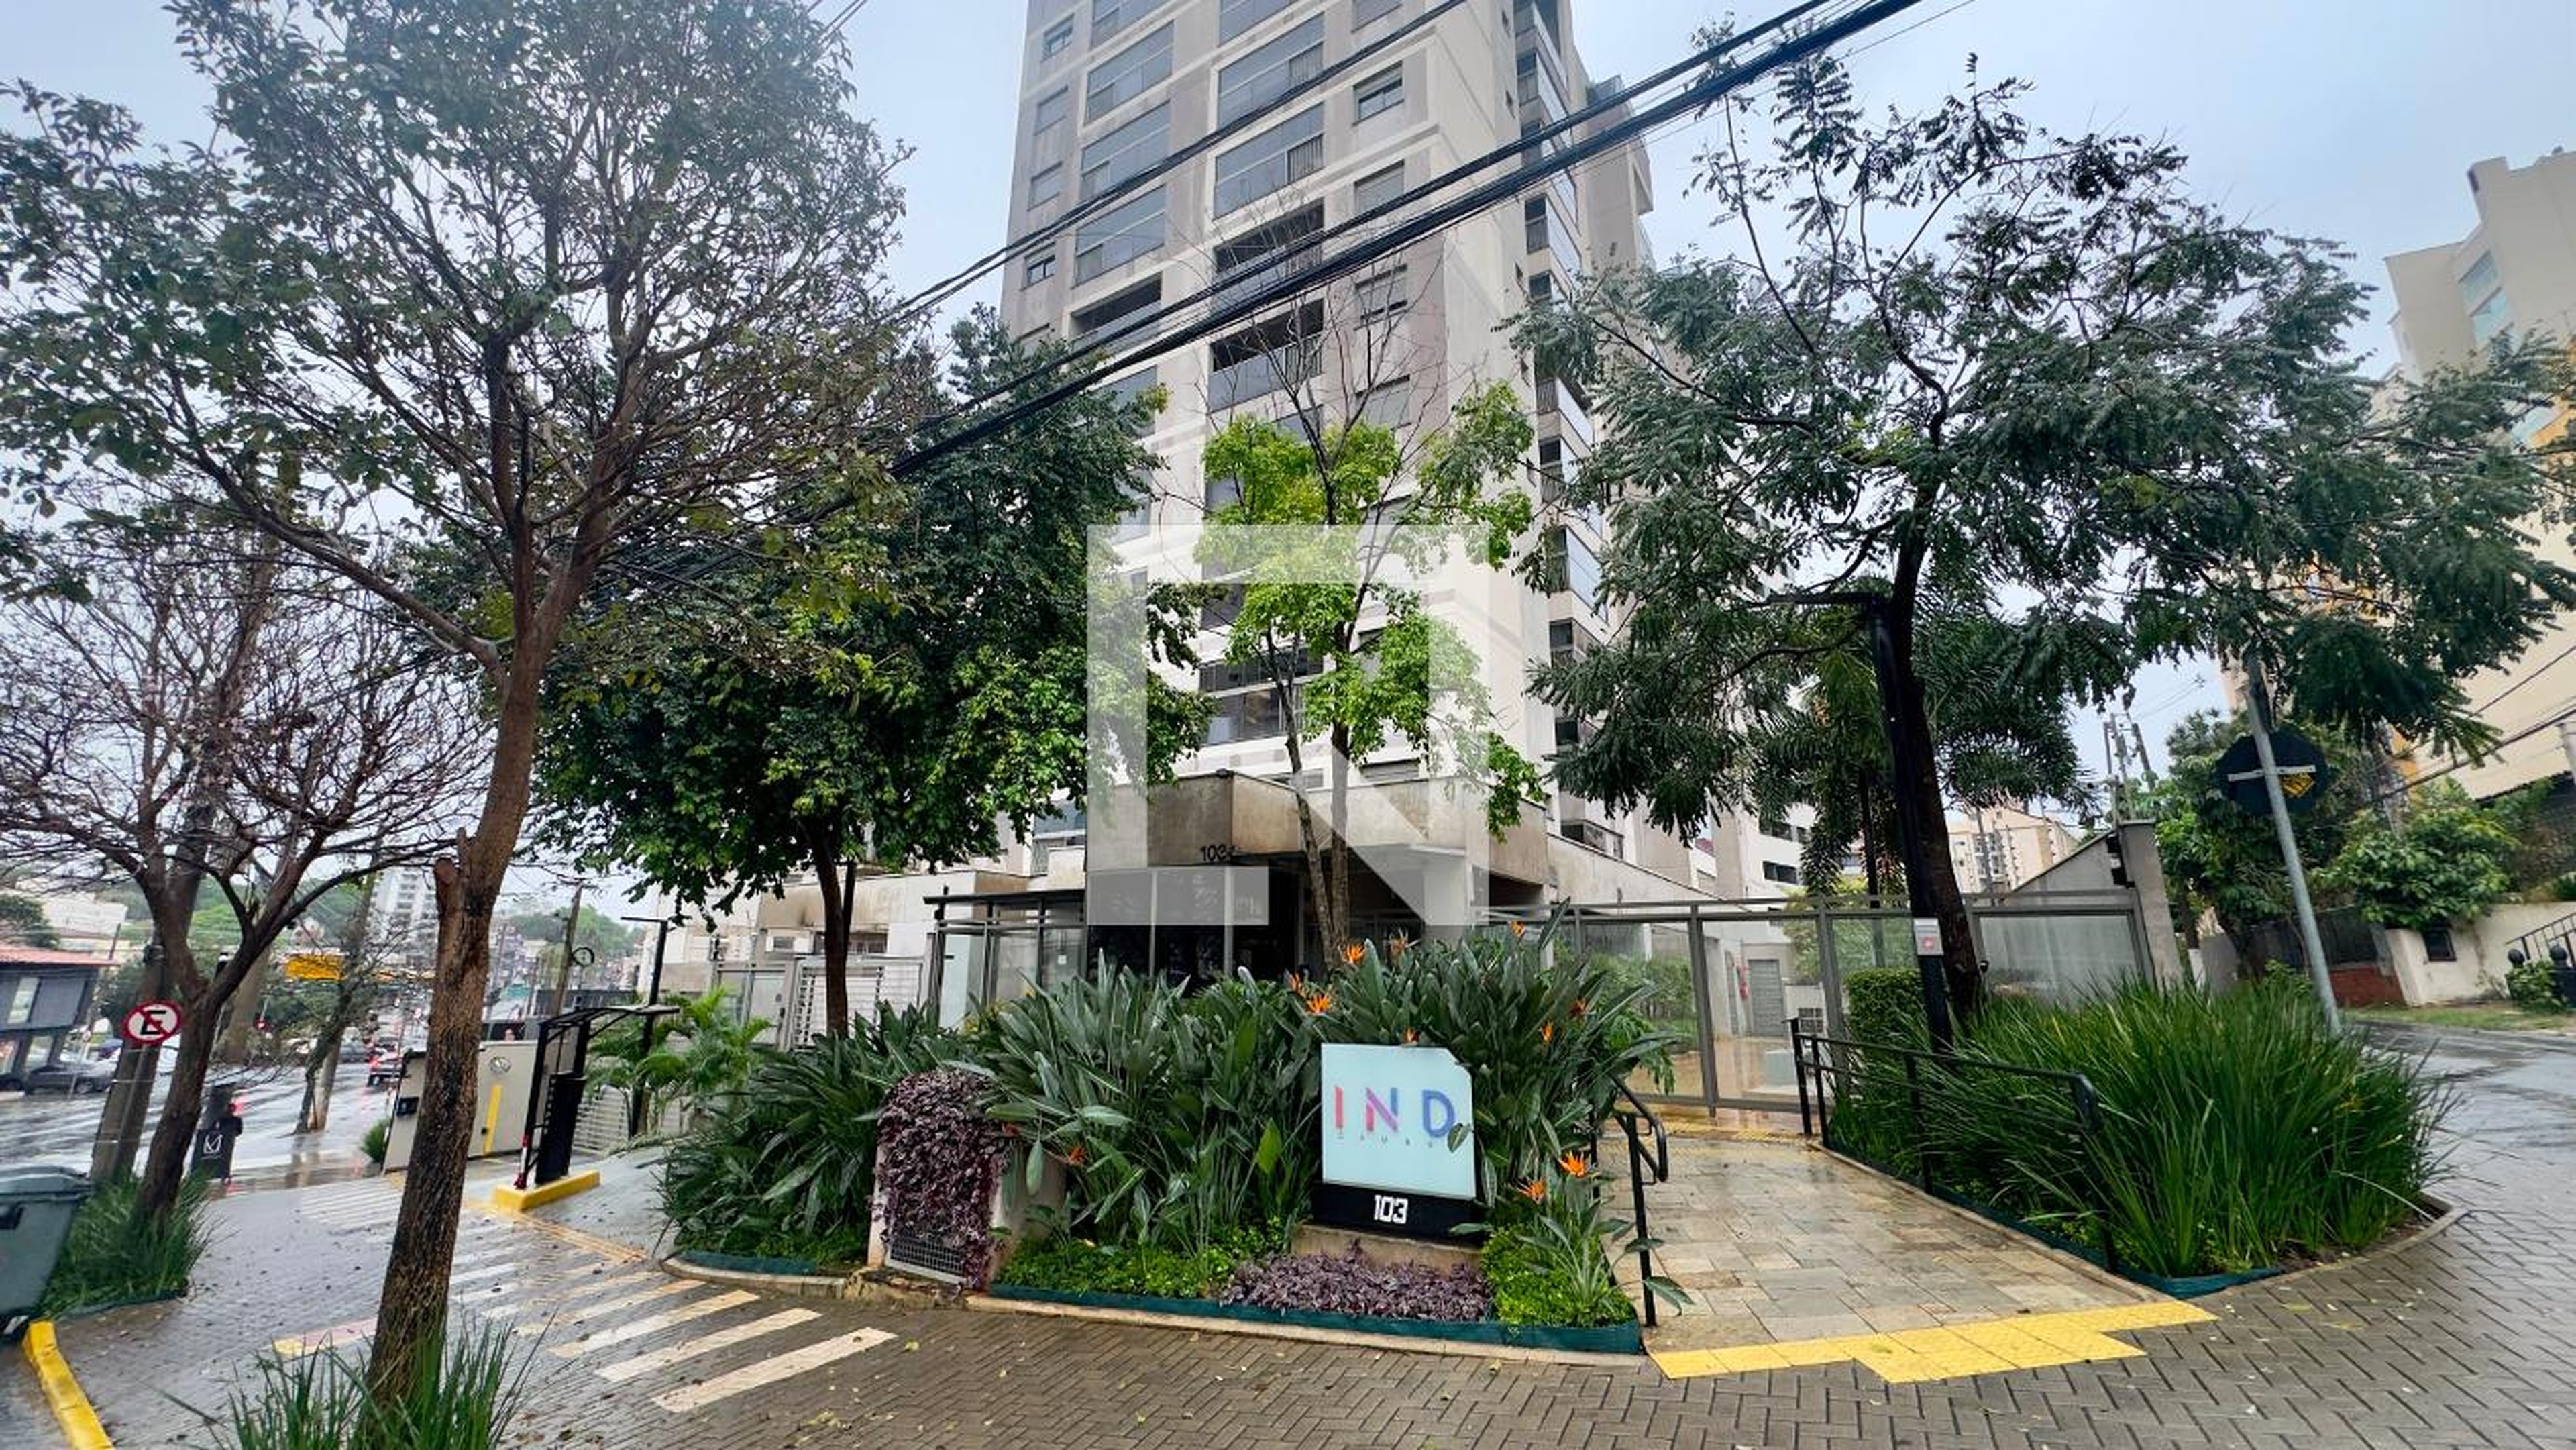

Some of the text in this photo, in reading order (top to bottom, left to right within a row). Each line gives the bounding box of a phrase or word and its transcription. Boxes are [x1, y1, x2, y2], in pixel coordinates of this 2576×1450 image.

[140, 1010, 166, 1035] E
[1334, 1086, 1456, 1138] IND
[1373, 1194, 1408, 1224] 103
